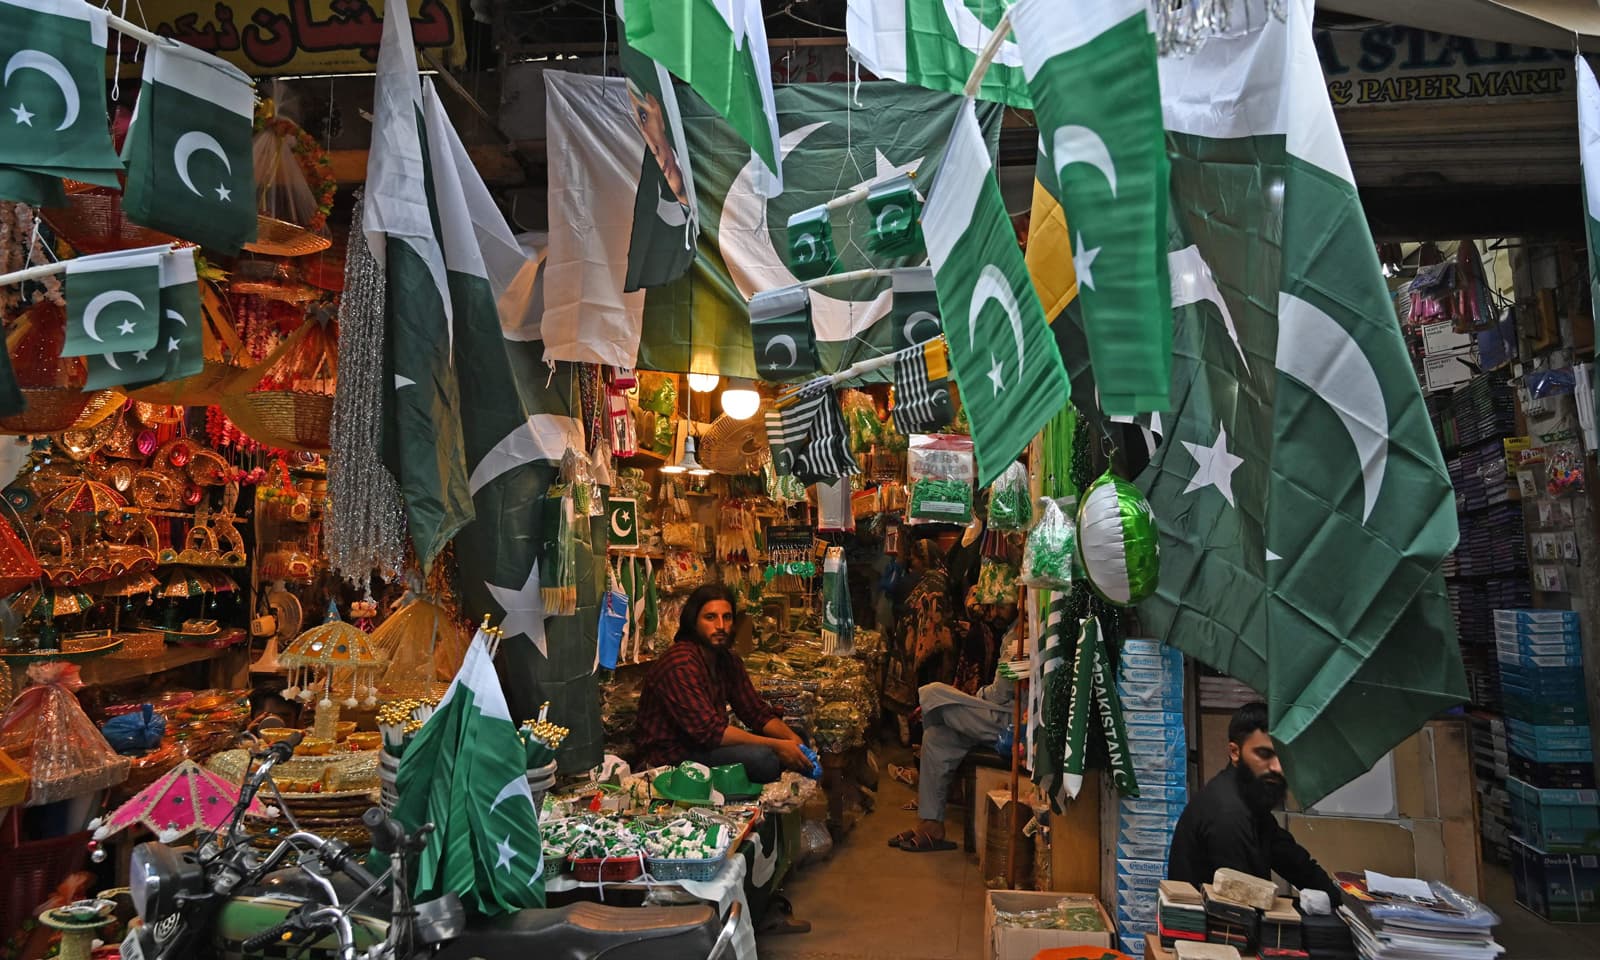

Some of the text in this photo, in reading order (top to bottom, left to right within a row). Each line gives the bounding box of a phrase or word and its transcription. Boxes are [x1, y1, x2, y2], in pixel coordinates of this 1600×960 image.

[1328, 68, 1566, 105] & PAPER MART
[1093, 673, 1124, 765] PAKISTAN
